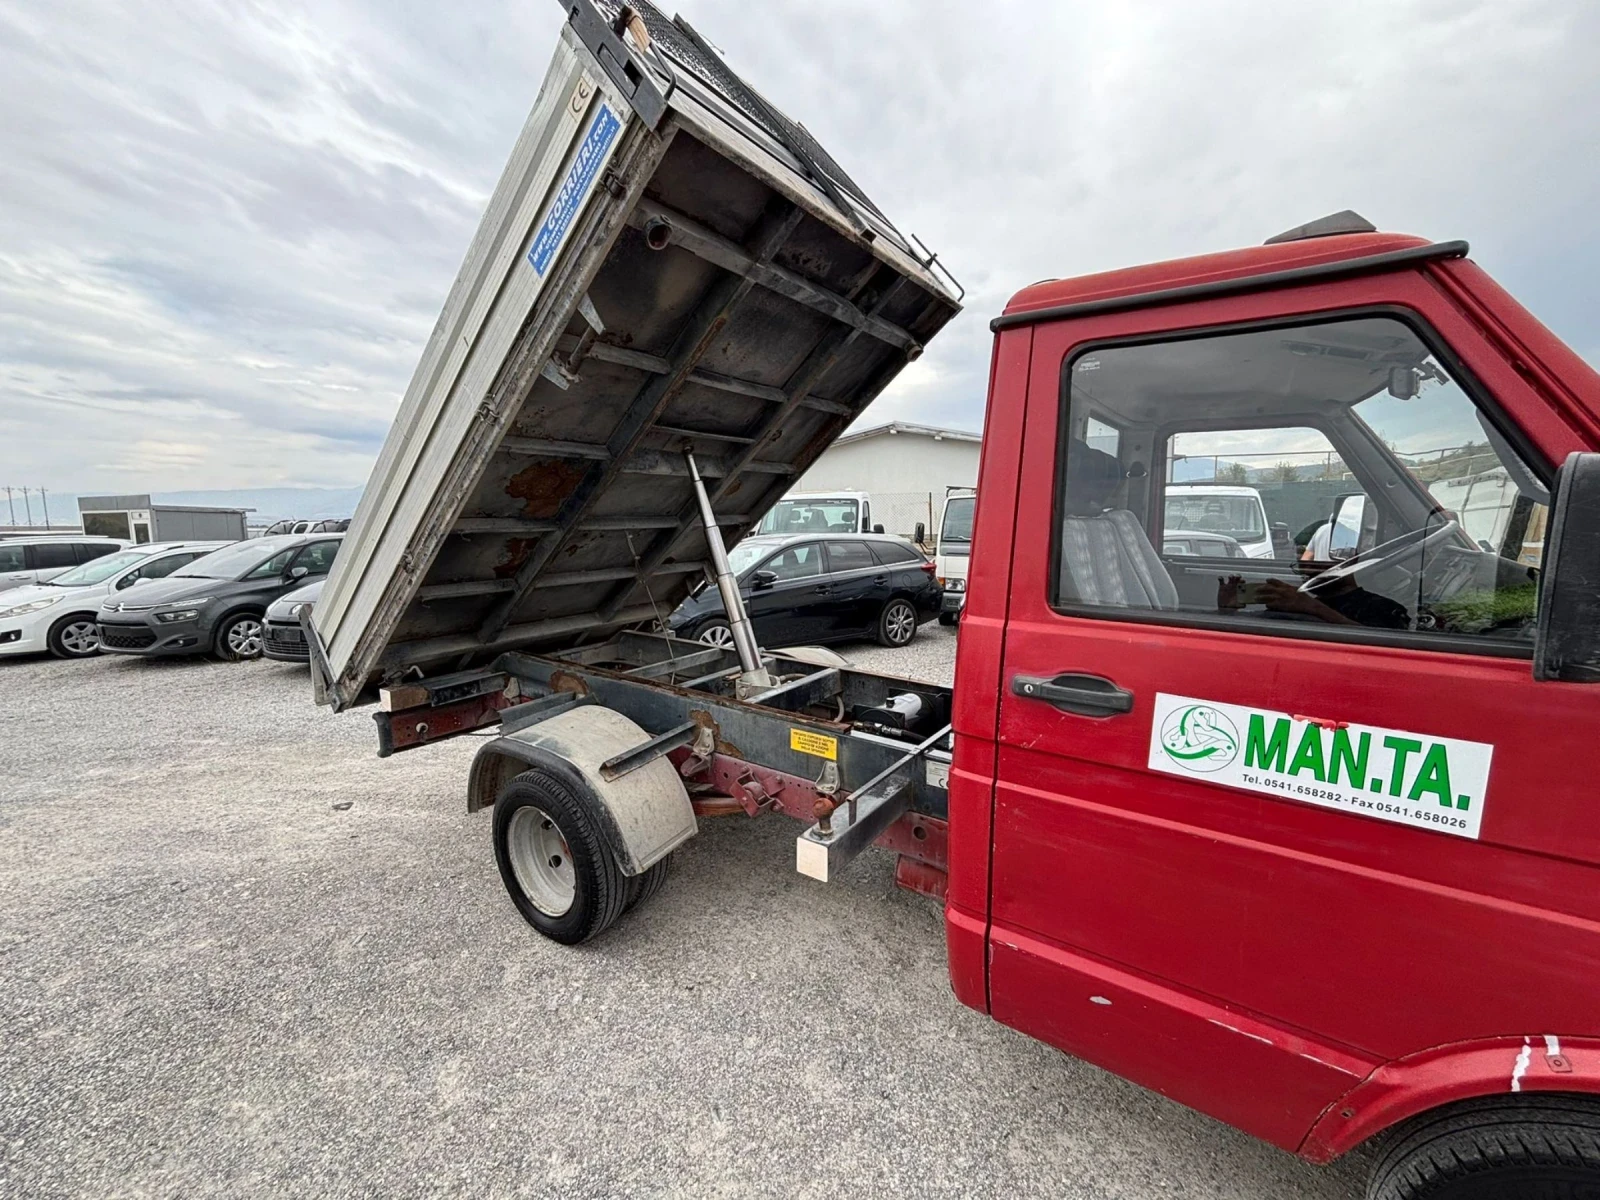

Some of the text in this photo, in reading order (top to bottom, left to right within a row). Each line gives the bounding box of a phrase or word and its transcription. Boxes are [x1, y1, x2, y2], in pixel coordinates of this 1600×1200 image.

[1244, 713, 1471, 811] MAN.TA.
[1264, 778, 1342, 803] 0541.658282
[1351, 796, 1374, 809] Fax
[1376, 802, 1467, 829] 0541.658026
